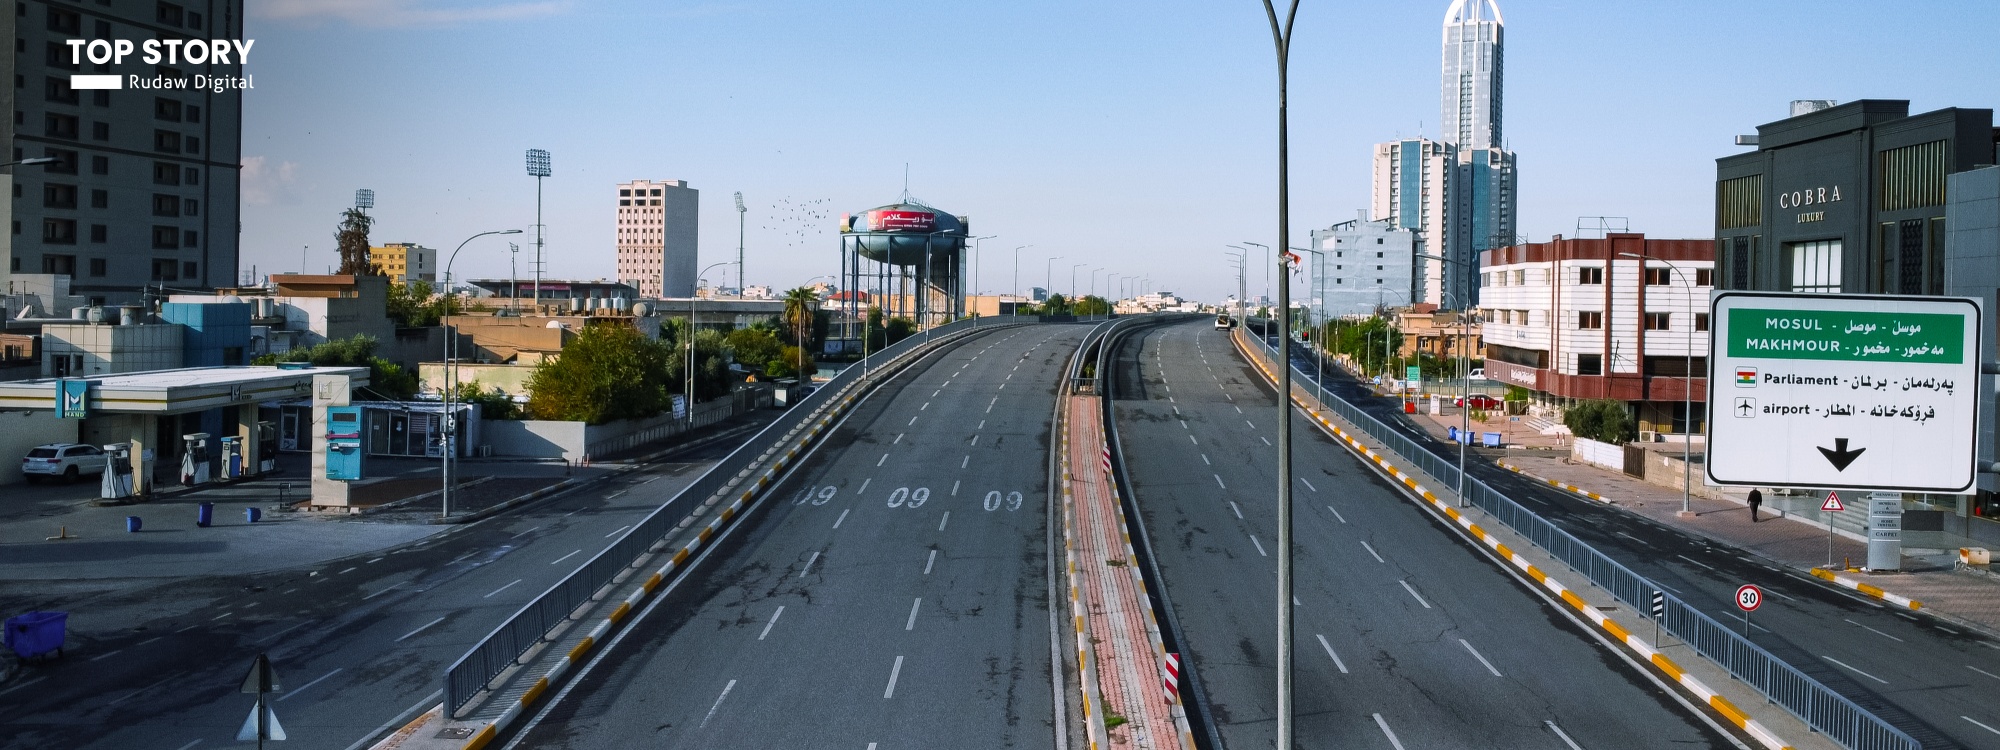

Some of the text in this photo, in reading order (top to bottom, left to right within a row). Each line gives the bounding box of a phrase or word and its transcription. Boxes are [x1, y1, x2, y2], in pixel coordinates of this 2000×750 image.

[1780, 185, 1841, 209] COBRA
[1797, 211, 1824, 224] LUXURY
[1765, 317, 1823, 331] MOSUL
[1844, 319, 1876, 335] موصل
[1746, 338, 1840, 352] MAKHMOUR
[1852, 341, 1890, 356] مخمور
[1764, 373, 1838, 386] Parliament
[1763, 403, 1810, 416] airport
[1822, 403, 1855, 418] المطار
[1742, 592, 1756, 604] 30
